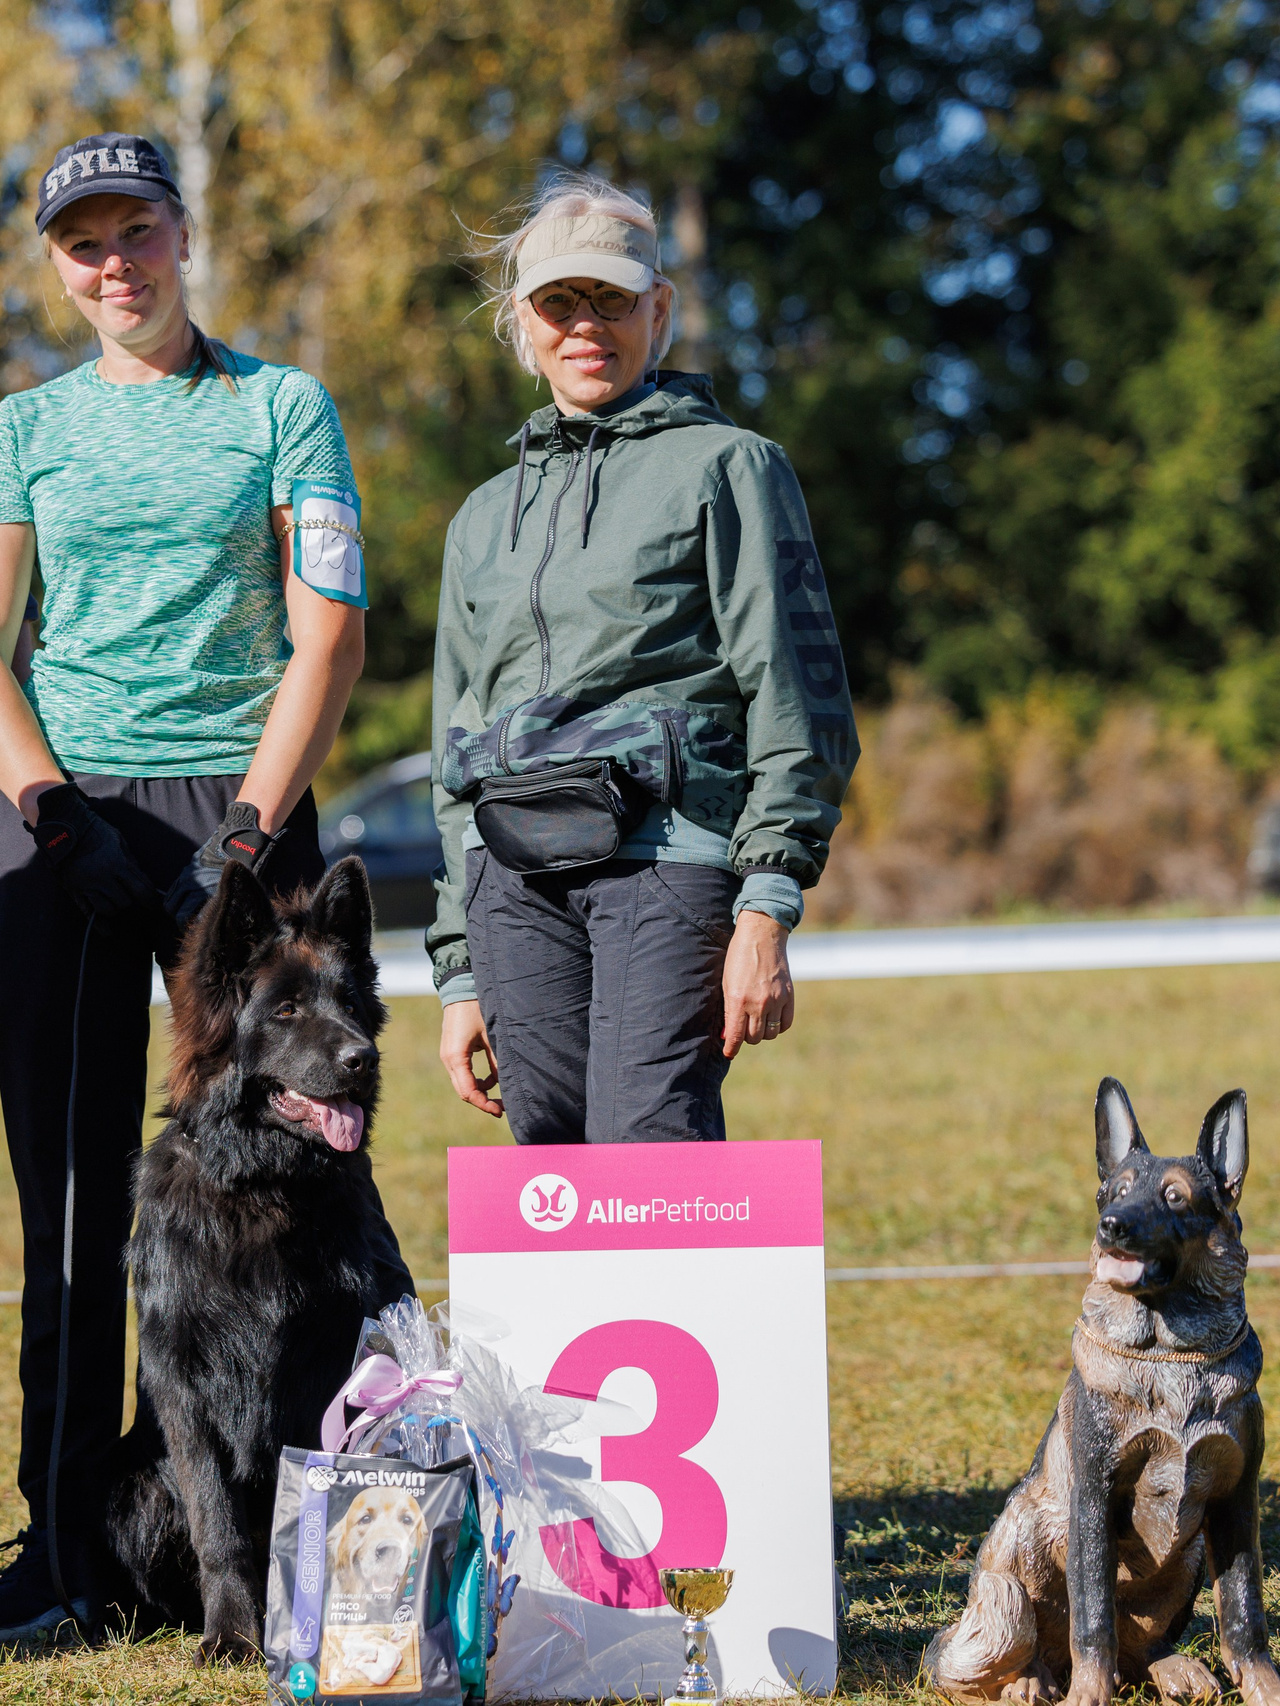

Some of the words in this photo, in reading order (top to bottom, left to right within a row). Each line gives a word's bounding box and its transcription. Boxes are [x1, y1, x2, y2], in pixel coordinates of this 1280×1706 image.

[46, 147, 140, 200] STYLE
[575, 240, 642, 257] SALOMON
[311, 485, 344, 497] Melwin
[775, 540, 850, 765] RIDE
[586, 1196, 750, 1224] AllerPetfood
[538, 1319, 728, 1609] 3
[341, 1469, 426, 1487] Melwin
[400, 1486, 426, 1498] dogs
[300, 1510, 322, 1594] SENIOR
[331, 1602, 360, 1611] МЯСО
[330, 1612, 367, 1622] ПТИЦЫ
[297, 1670, 307, 1683] 1
